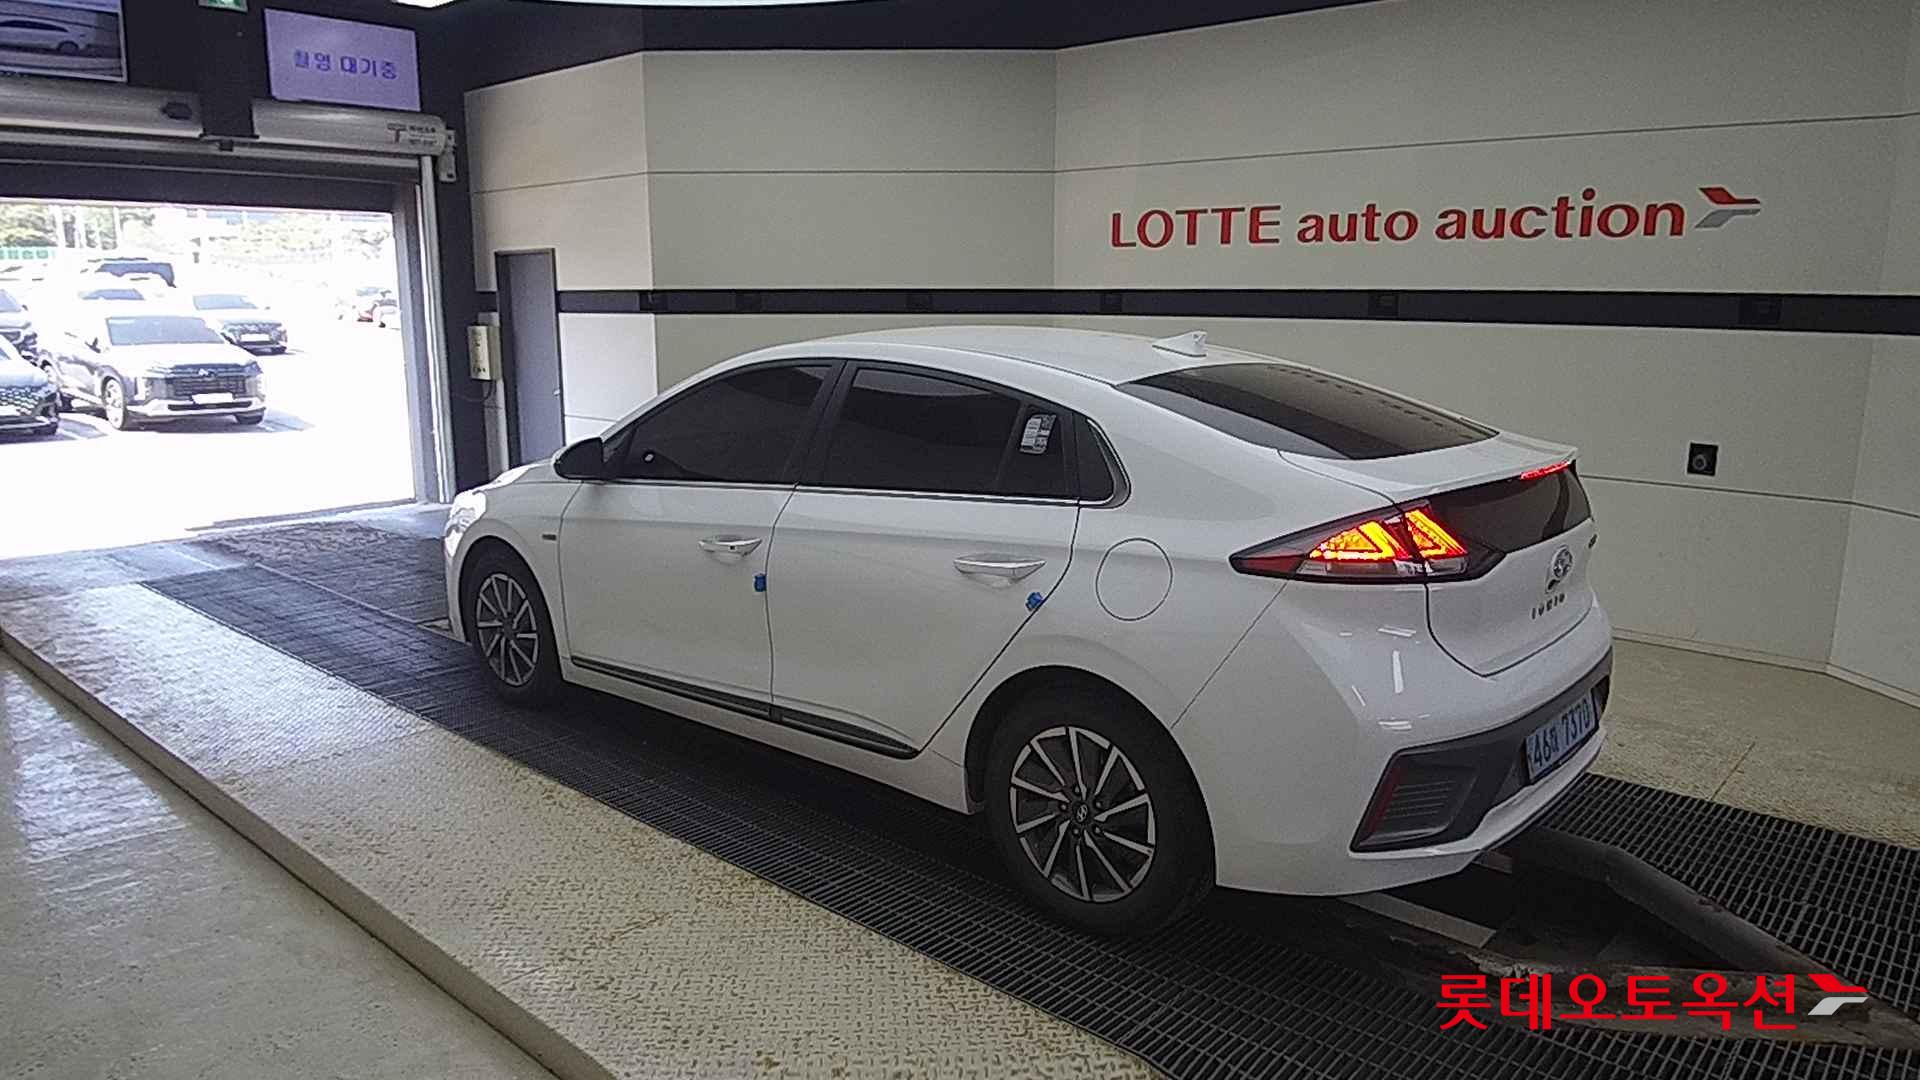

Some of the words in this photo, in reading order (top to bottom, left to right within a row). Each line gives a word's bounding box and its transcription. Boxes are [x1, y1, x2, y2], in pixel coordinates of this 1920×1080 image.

[340, 55, 397, 80] 대기중
[1112, 206, 1281, 248] LOTTE
[1298, 204, 1419, 242] auto
[1436, 188, 1686, 240] auction
